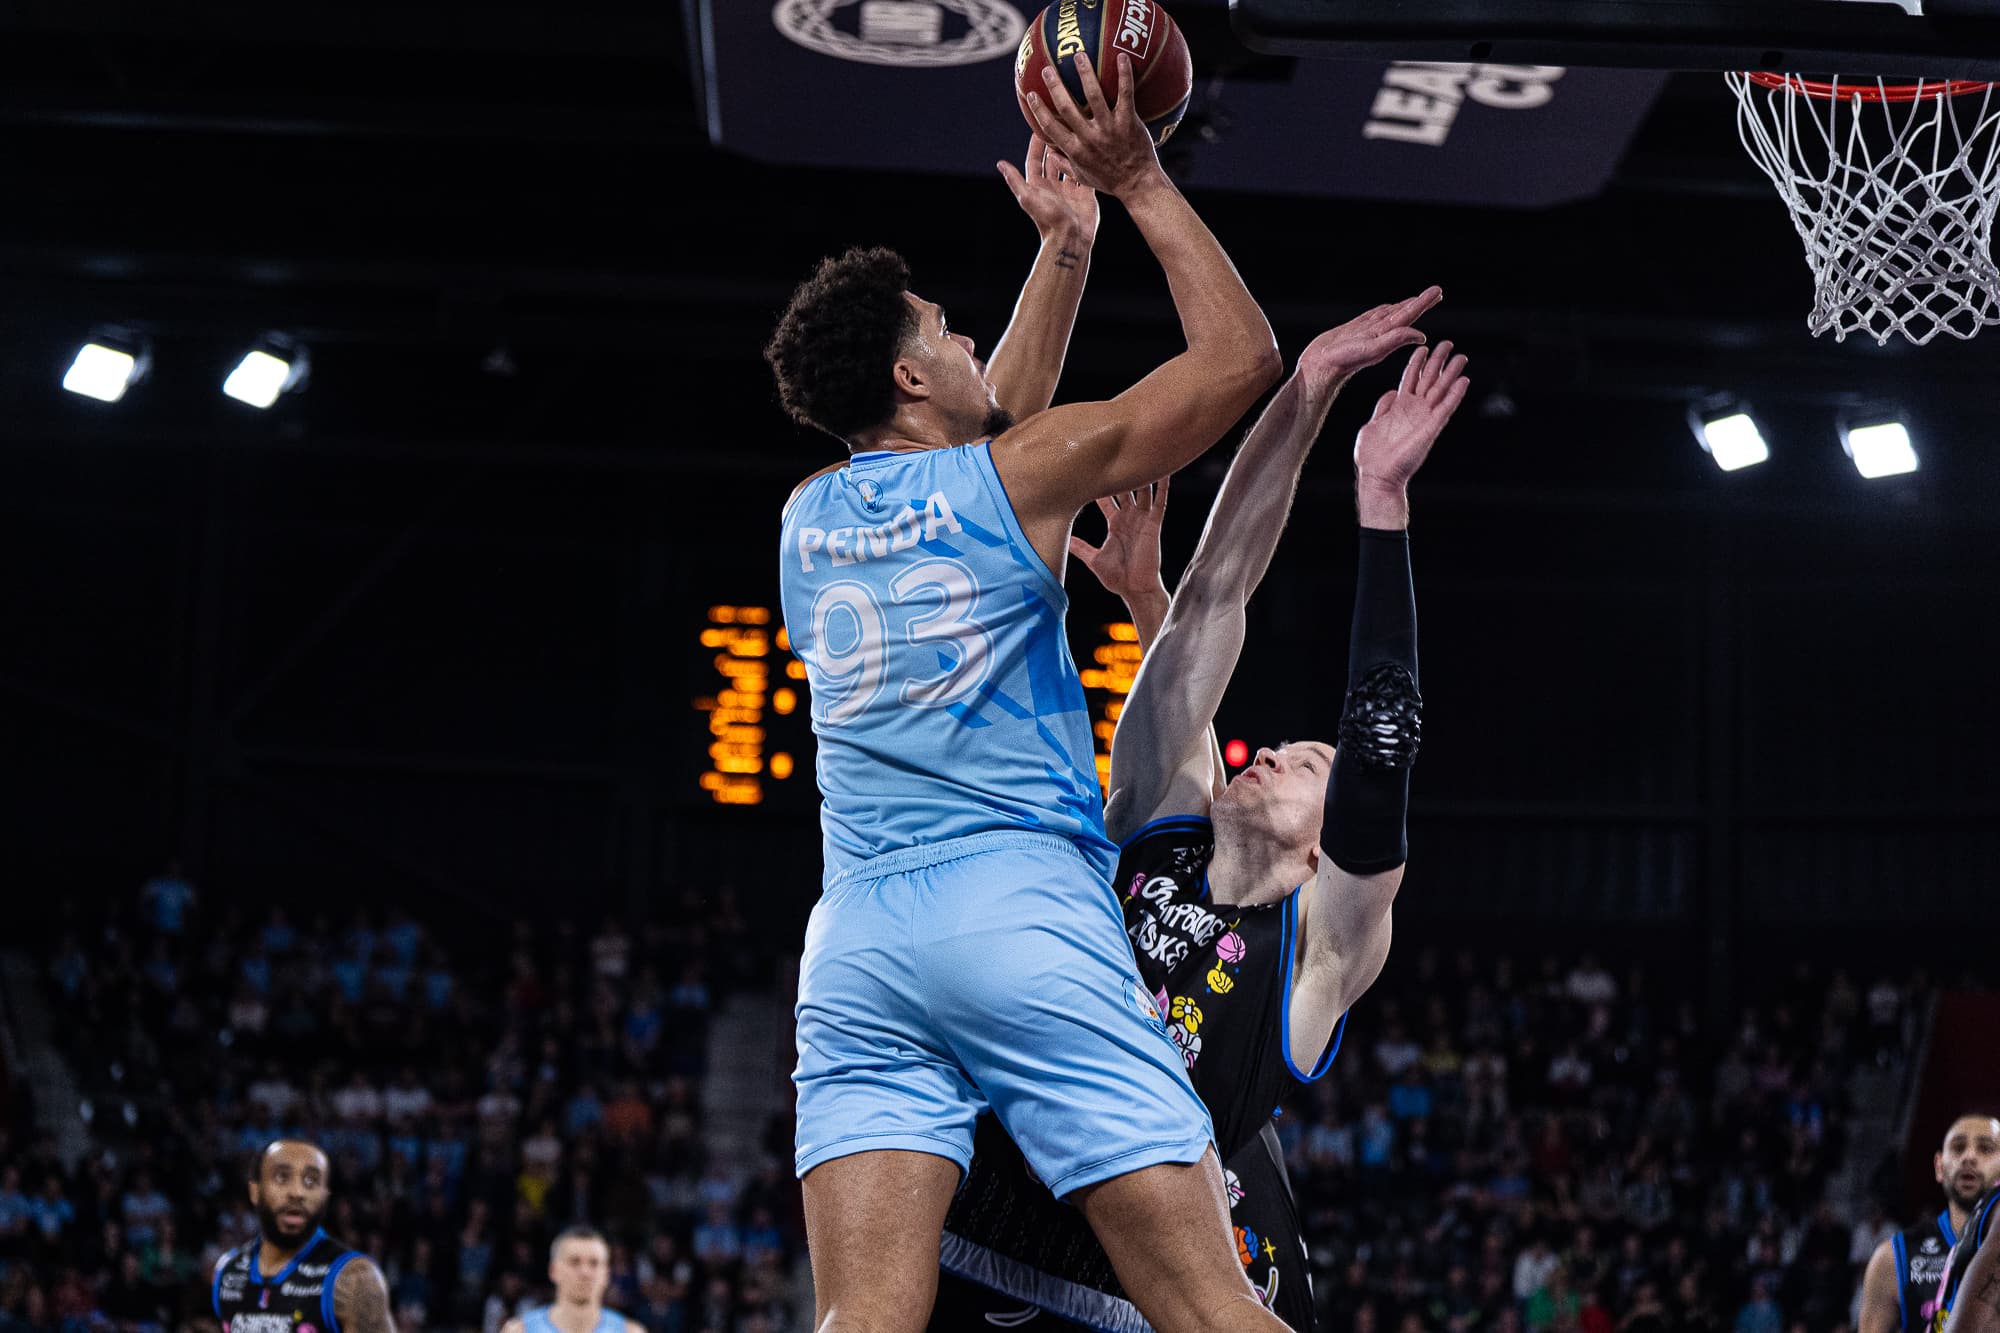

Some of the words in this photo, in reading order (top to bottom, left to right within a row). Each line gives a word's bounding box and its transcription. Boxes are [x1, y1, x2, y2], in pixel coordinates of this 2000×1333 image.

[1362, 61, 1473, 147] LEA
[798, 490, 963, 574] PENDA
[810, 556, 996, 731] 93
